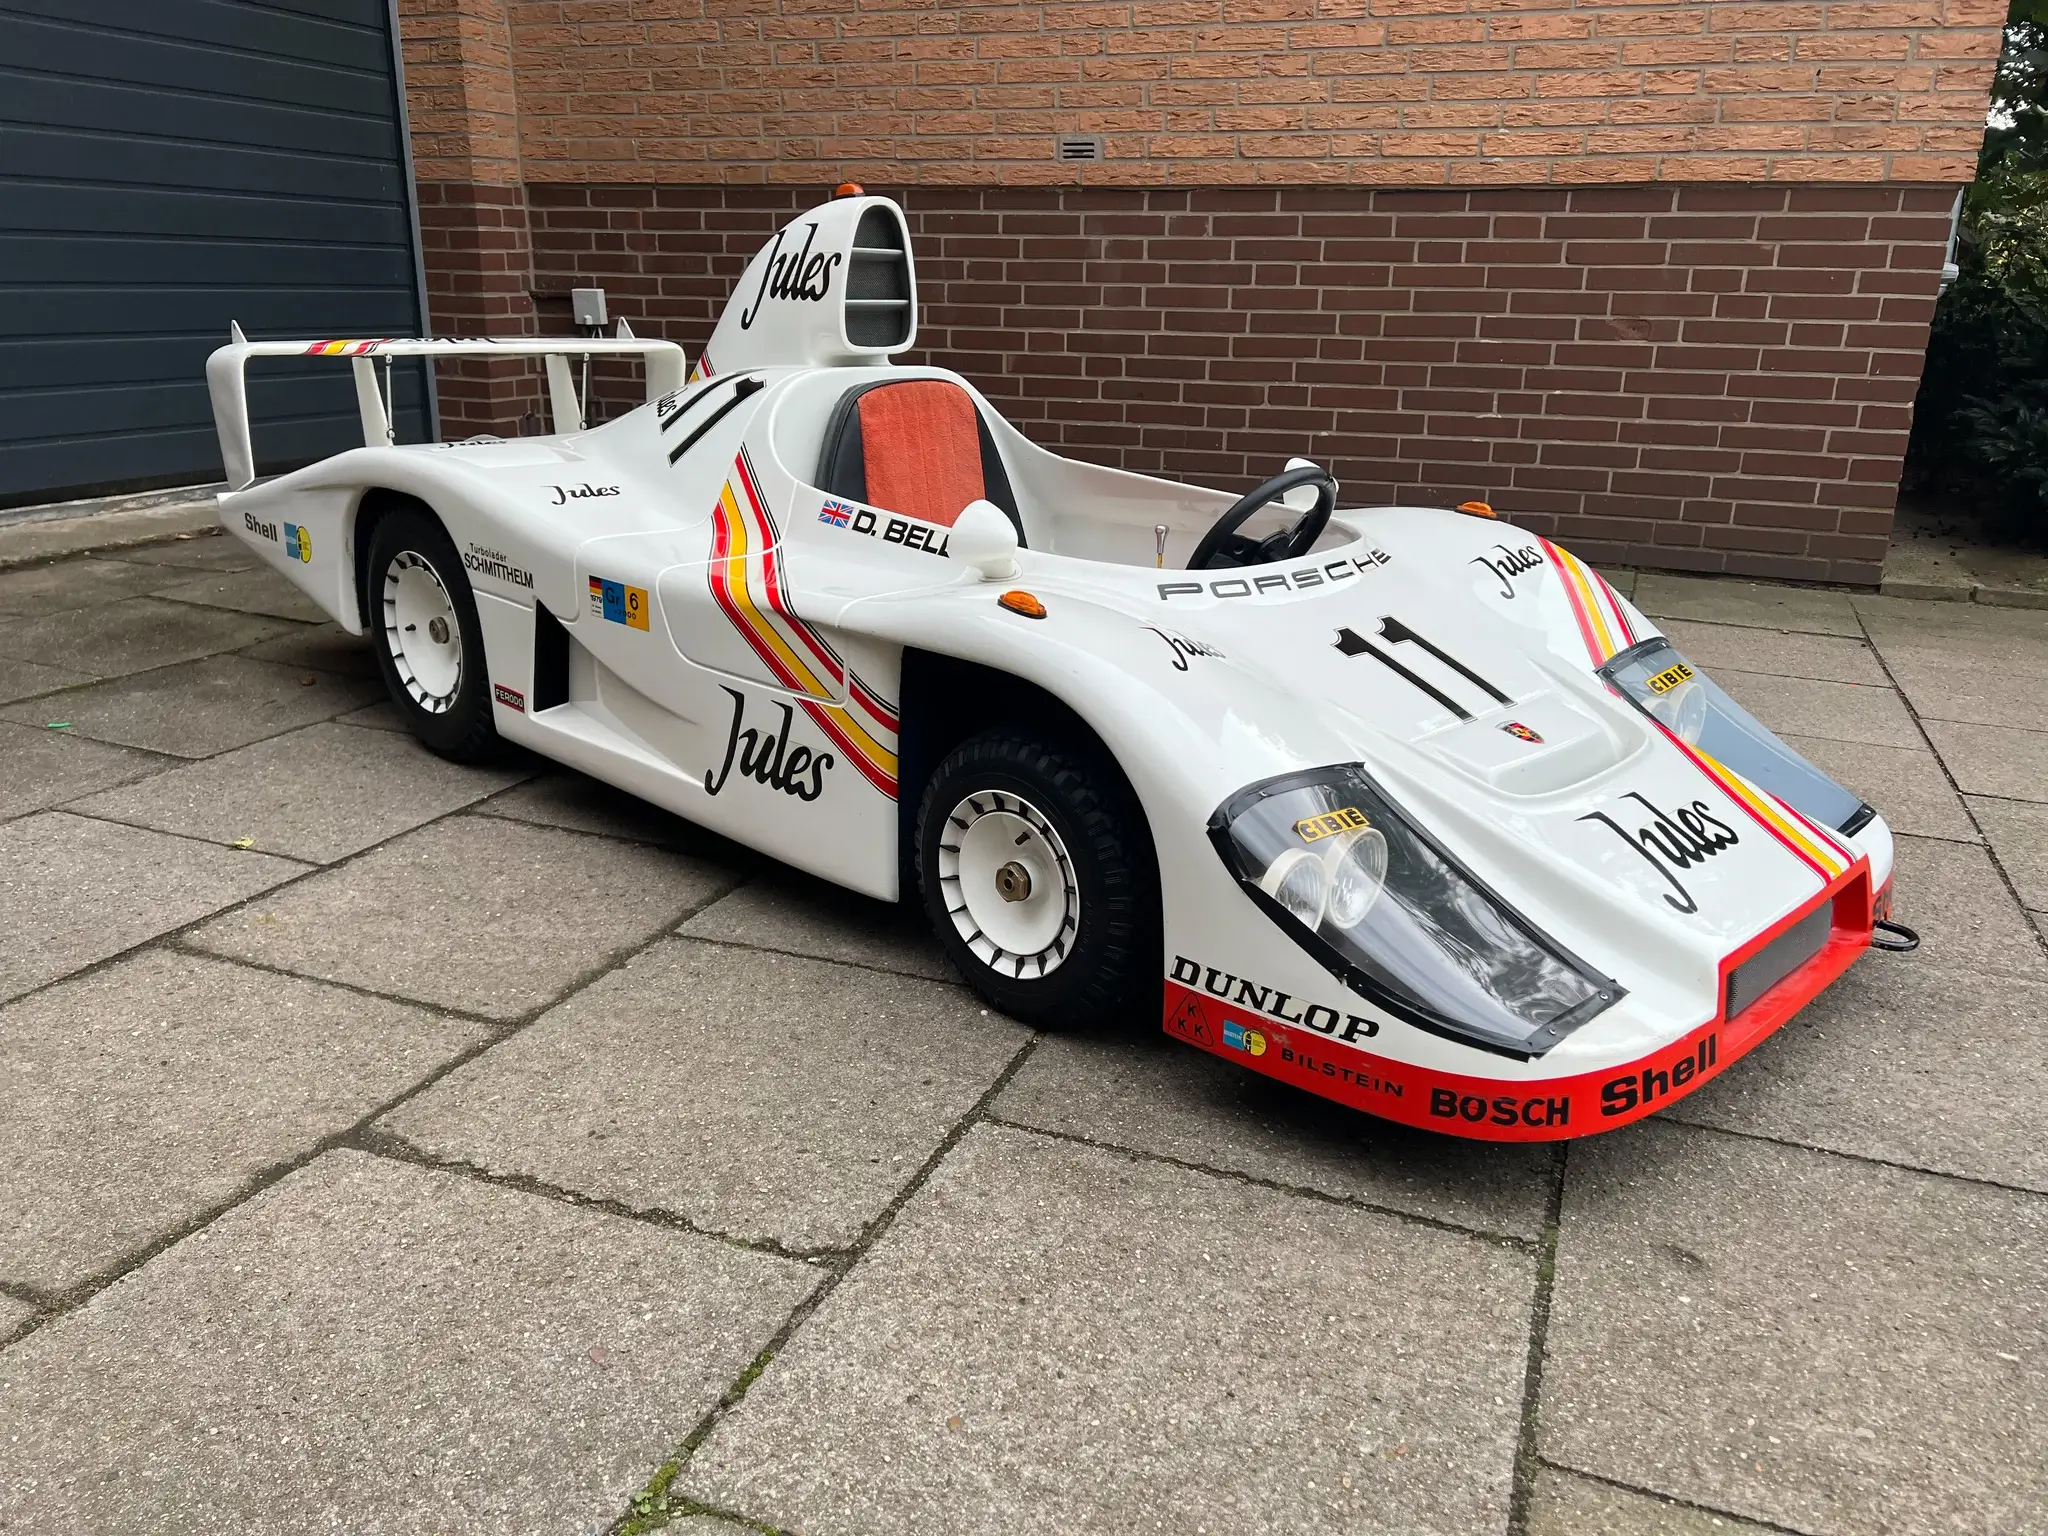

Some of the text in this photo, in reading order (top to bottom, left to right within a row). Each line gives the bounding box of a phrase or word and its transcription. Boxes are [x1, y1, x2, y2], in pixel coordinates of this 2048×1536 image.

[741, 223, 842, 330] Jules
[543, 483, 622, 505] Jules
[244, 512, 278, 542] Shell
[852, 509, 877, 537] D.
[464, 553, 534, 589] SCHMITTHELM
[469, 542, 507, 562] Turbolader
[1467, 543, 1544, 600] Jules
[1157, 547, 1391, 601] PORSCHE
[629, 592, 639, 611] 6
[1138, 626, 1227, 672] Jules
[1330, 614, 1518, 724] 11
[495, 689, 524, 708] FERODO
[705, 683, 835, 803] Jules
[1300, 808, 1367, 839] CIBIÉ
[1575, 790, 1740, 915] Jules
[1169, 954, 1380, 1044] DUNLOP
[1187, 1003, 1197, 1018] K
[1178, 1017, 1205, 1040] K K
[1281, 1047, 1404, 1097] BILSTEIN
[1601, 1033, 1717, 1117] Shell
[1430, 1087, 1570, 1127] BOSCH
